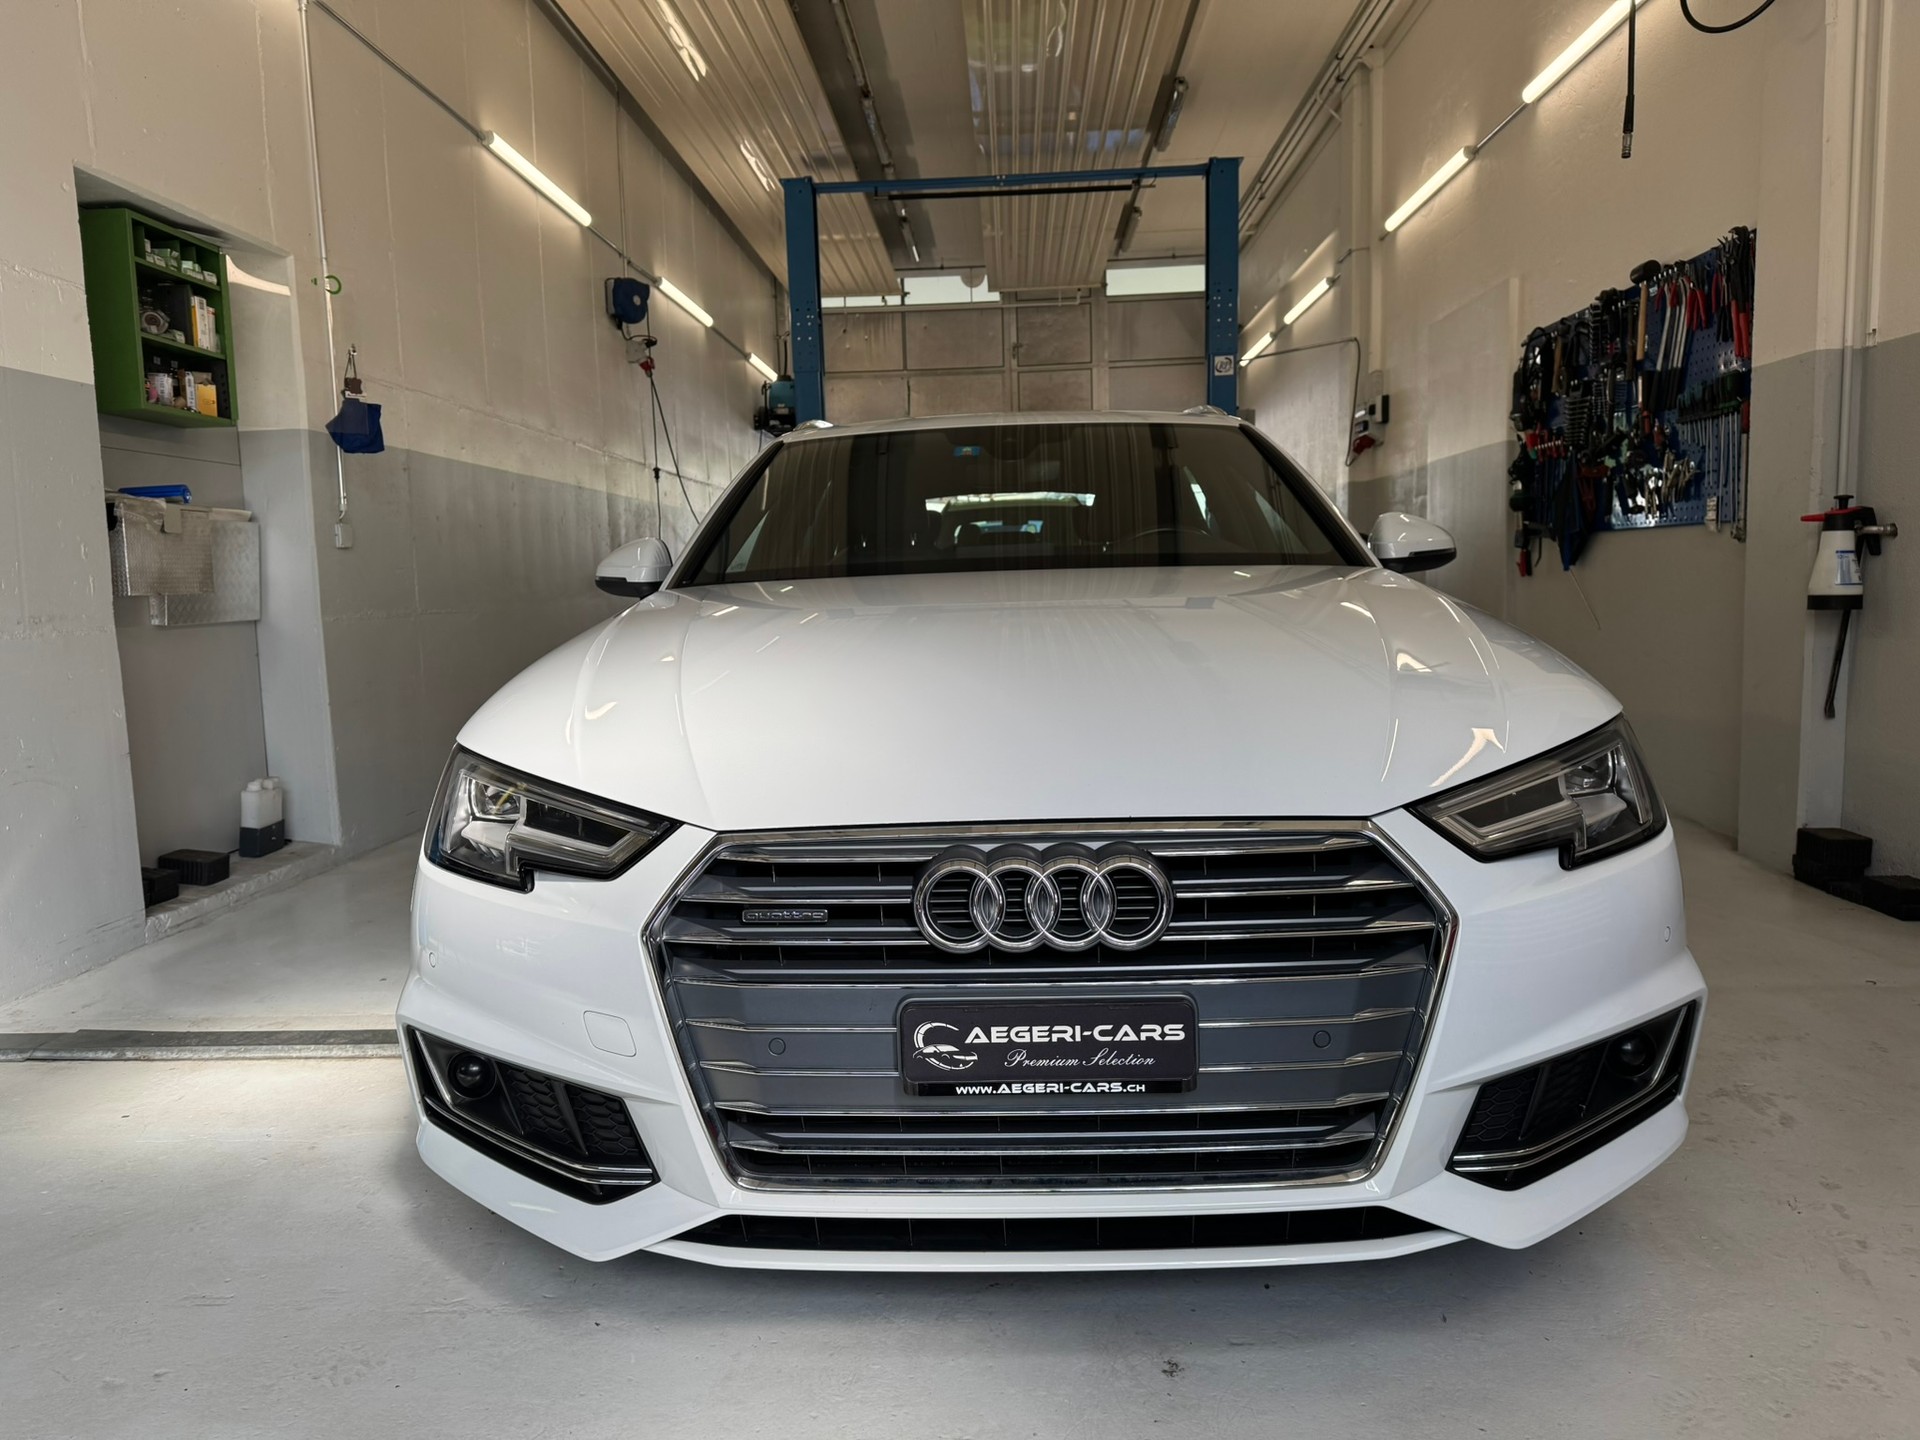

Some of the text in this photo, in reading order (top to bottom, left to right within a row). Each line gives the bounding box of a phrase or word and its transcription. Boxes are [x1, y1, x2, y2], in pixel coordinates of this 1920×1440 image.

[746, 910, 824, 920] quattro
[964, 1024, 1186, 1044] AEGERI-CARS
[1004, 1047, 1157, 1068] Premium Selection
